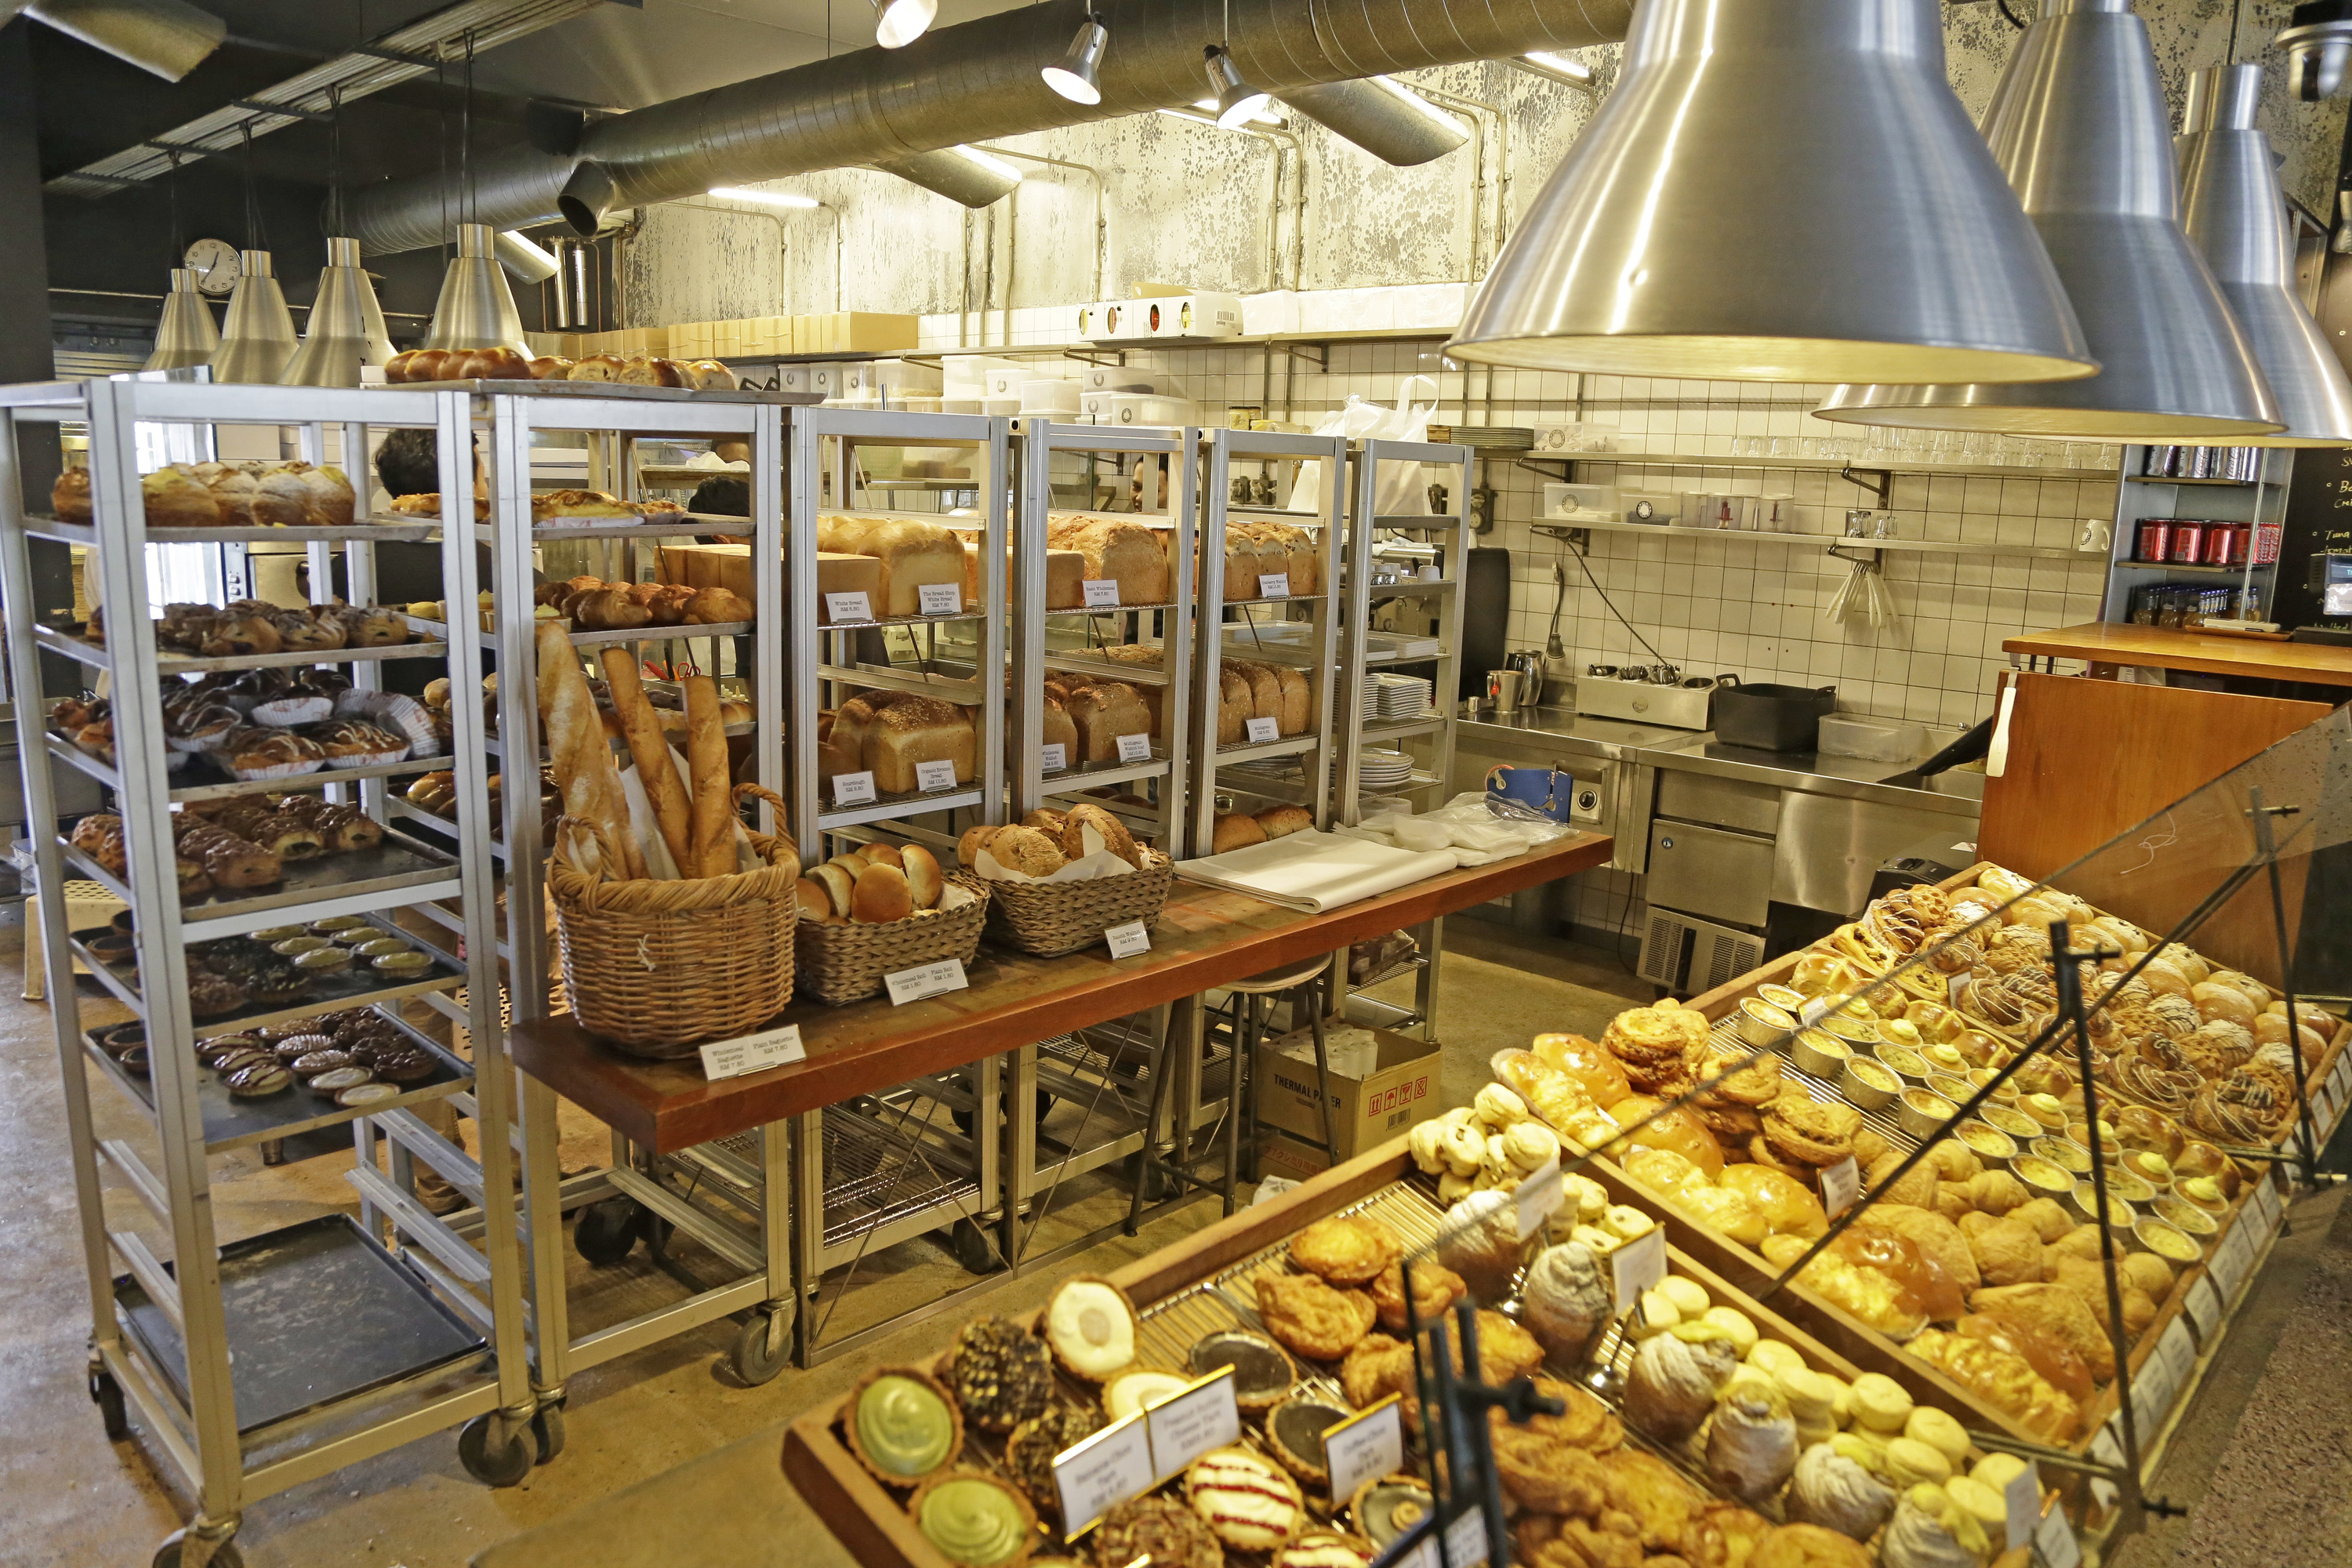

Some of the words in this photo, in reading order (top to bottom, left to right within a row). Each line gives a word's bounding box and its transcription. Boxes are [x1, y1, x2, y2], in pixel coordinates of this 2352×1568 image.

[2325, 530, 2350, 540] Tuna
[891, 976, 916, 985] Wholemeal
[769, 1036, 794, 1045] Baguette
[713, 1045, 744, 1056] Wholemeal
[717, 1054, 743, 1063] Baguette
[1274, 1073, 1312, 1098] THERMAL
